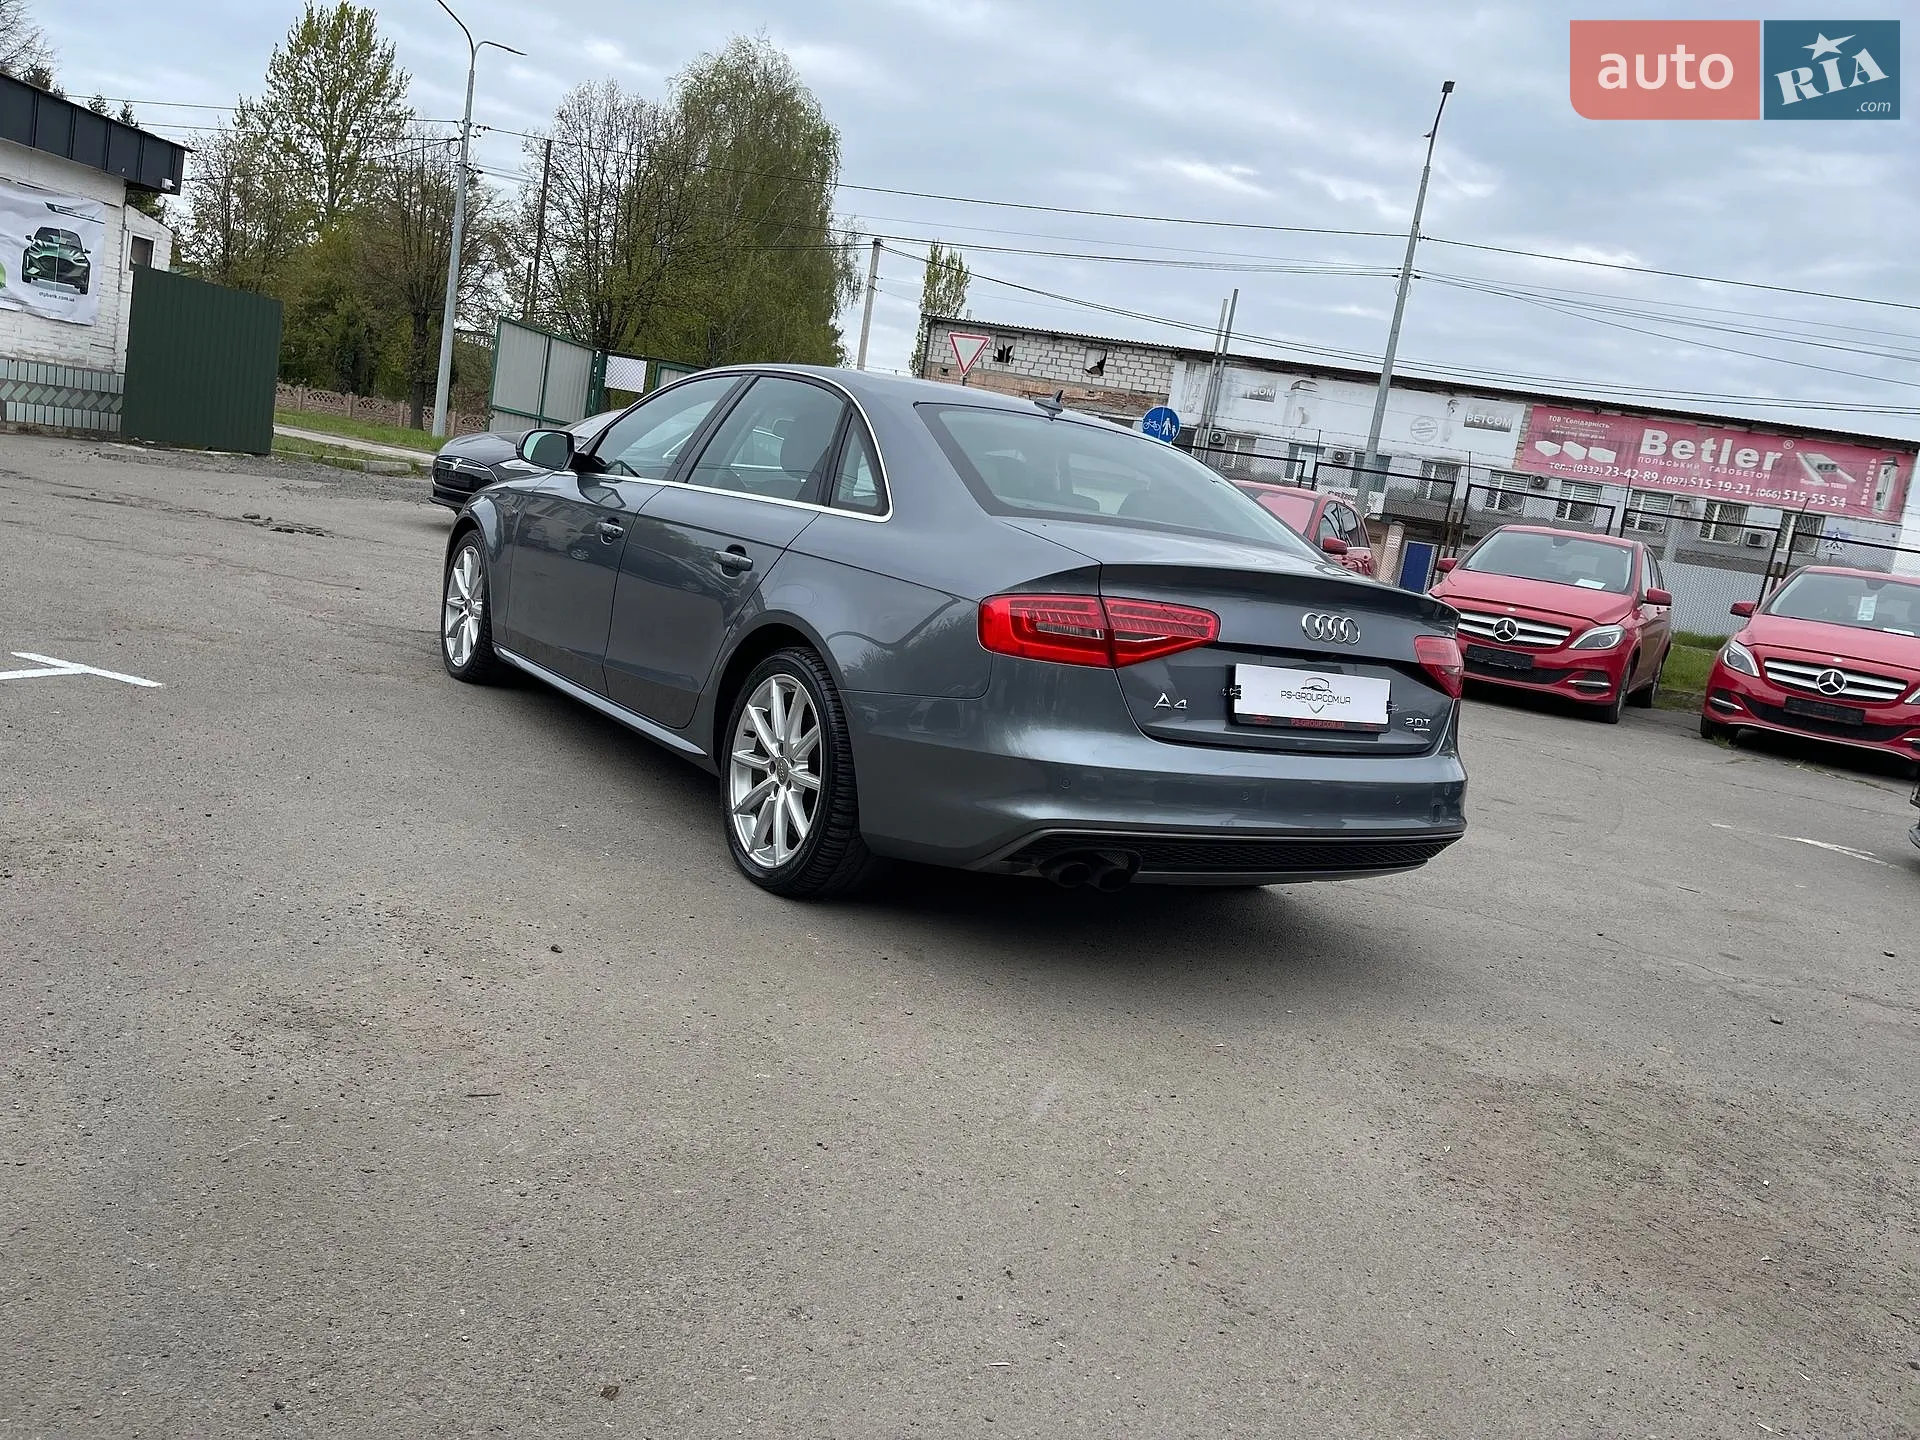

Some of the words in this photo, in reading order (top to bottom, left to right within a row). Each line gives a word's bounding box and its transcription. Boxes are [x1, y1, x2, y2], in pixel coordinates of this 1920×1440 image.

[1639, 428, 1783, 471] Betler
[1573, 463, 1603, 476] (0332)
[1662, 475, 1688, 487] (097)
[1755, 487, 1781, 500] (066)
[1708, 465, 1770, 480] ГАЗОБЕТОН
[1153, 692, 1188, 710] A4
